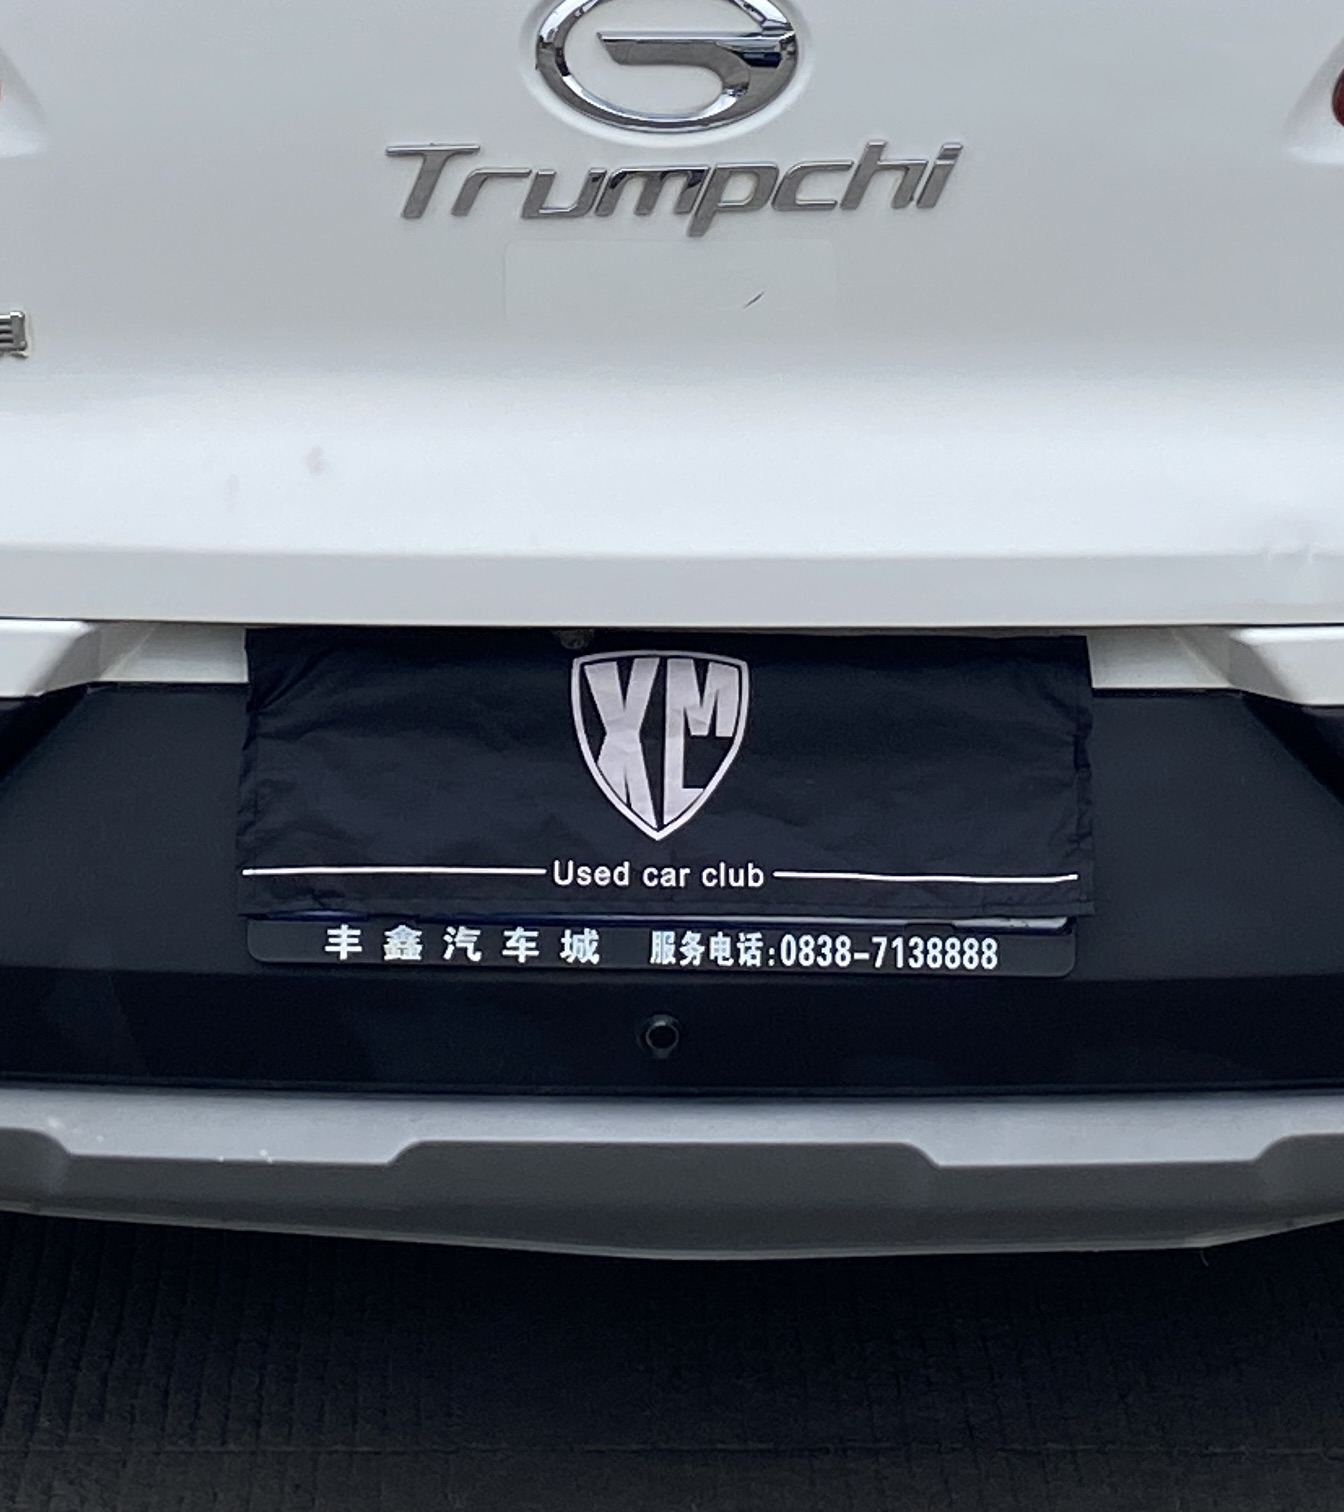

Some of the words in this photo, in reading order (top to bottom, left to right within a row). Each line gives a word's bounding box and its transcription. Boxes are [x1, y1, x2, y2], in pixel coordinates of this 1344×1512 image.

[384, 140, 965, 238] Trumpchi
[553, 859, 630, 886] Used
[642, 866, 691, 887] car
[702, 861, 764, 887] club
[324, 924, 601, 964] 丰鑫汽车城
[649, 930, 999, 970] 服务电话:0838-7138888
